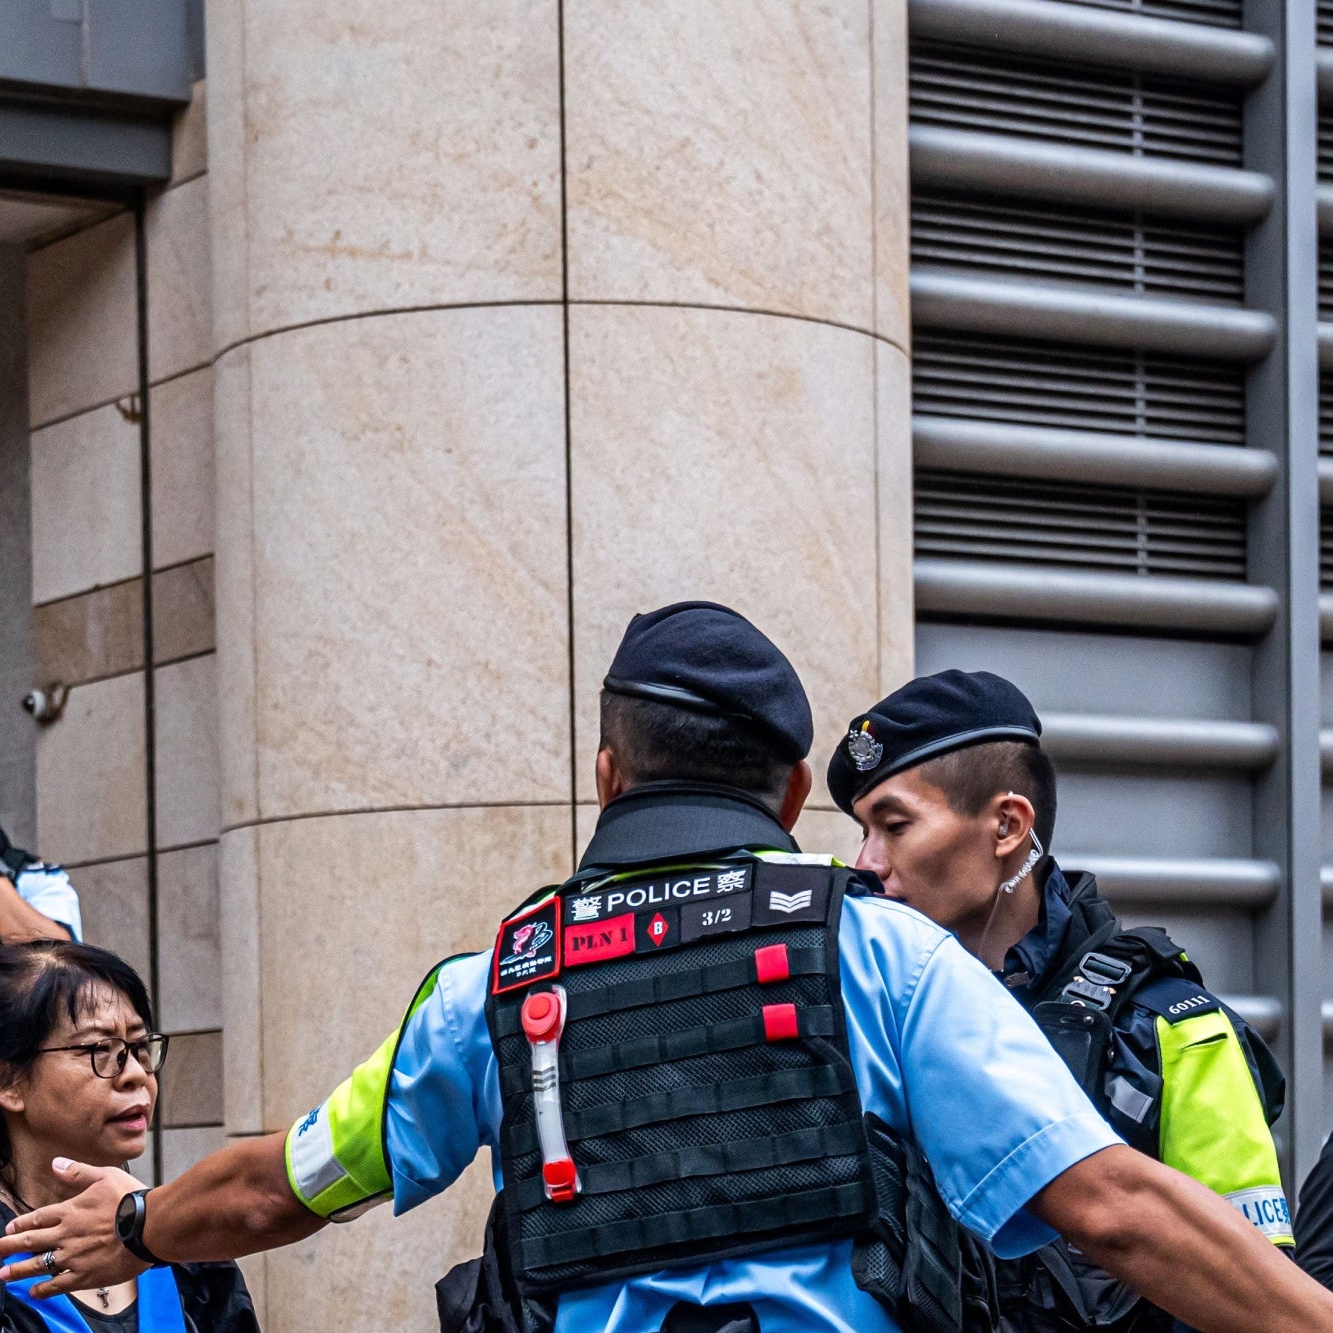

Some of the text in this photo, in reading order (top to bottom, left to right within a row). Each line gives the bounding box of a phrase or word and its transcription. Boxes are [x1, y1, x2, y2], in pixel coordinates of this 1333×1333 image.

[571, 869, 746, 921] 警 POLICE 察
[702, 908, 732, 926] 3/2
[653, 921, 663, 935] B
[571, 928, 628, 952] PLN 1
[1169, 995, 1211, 1015] 60111
